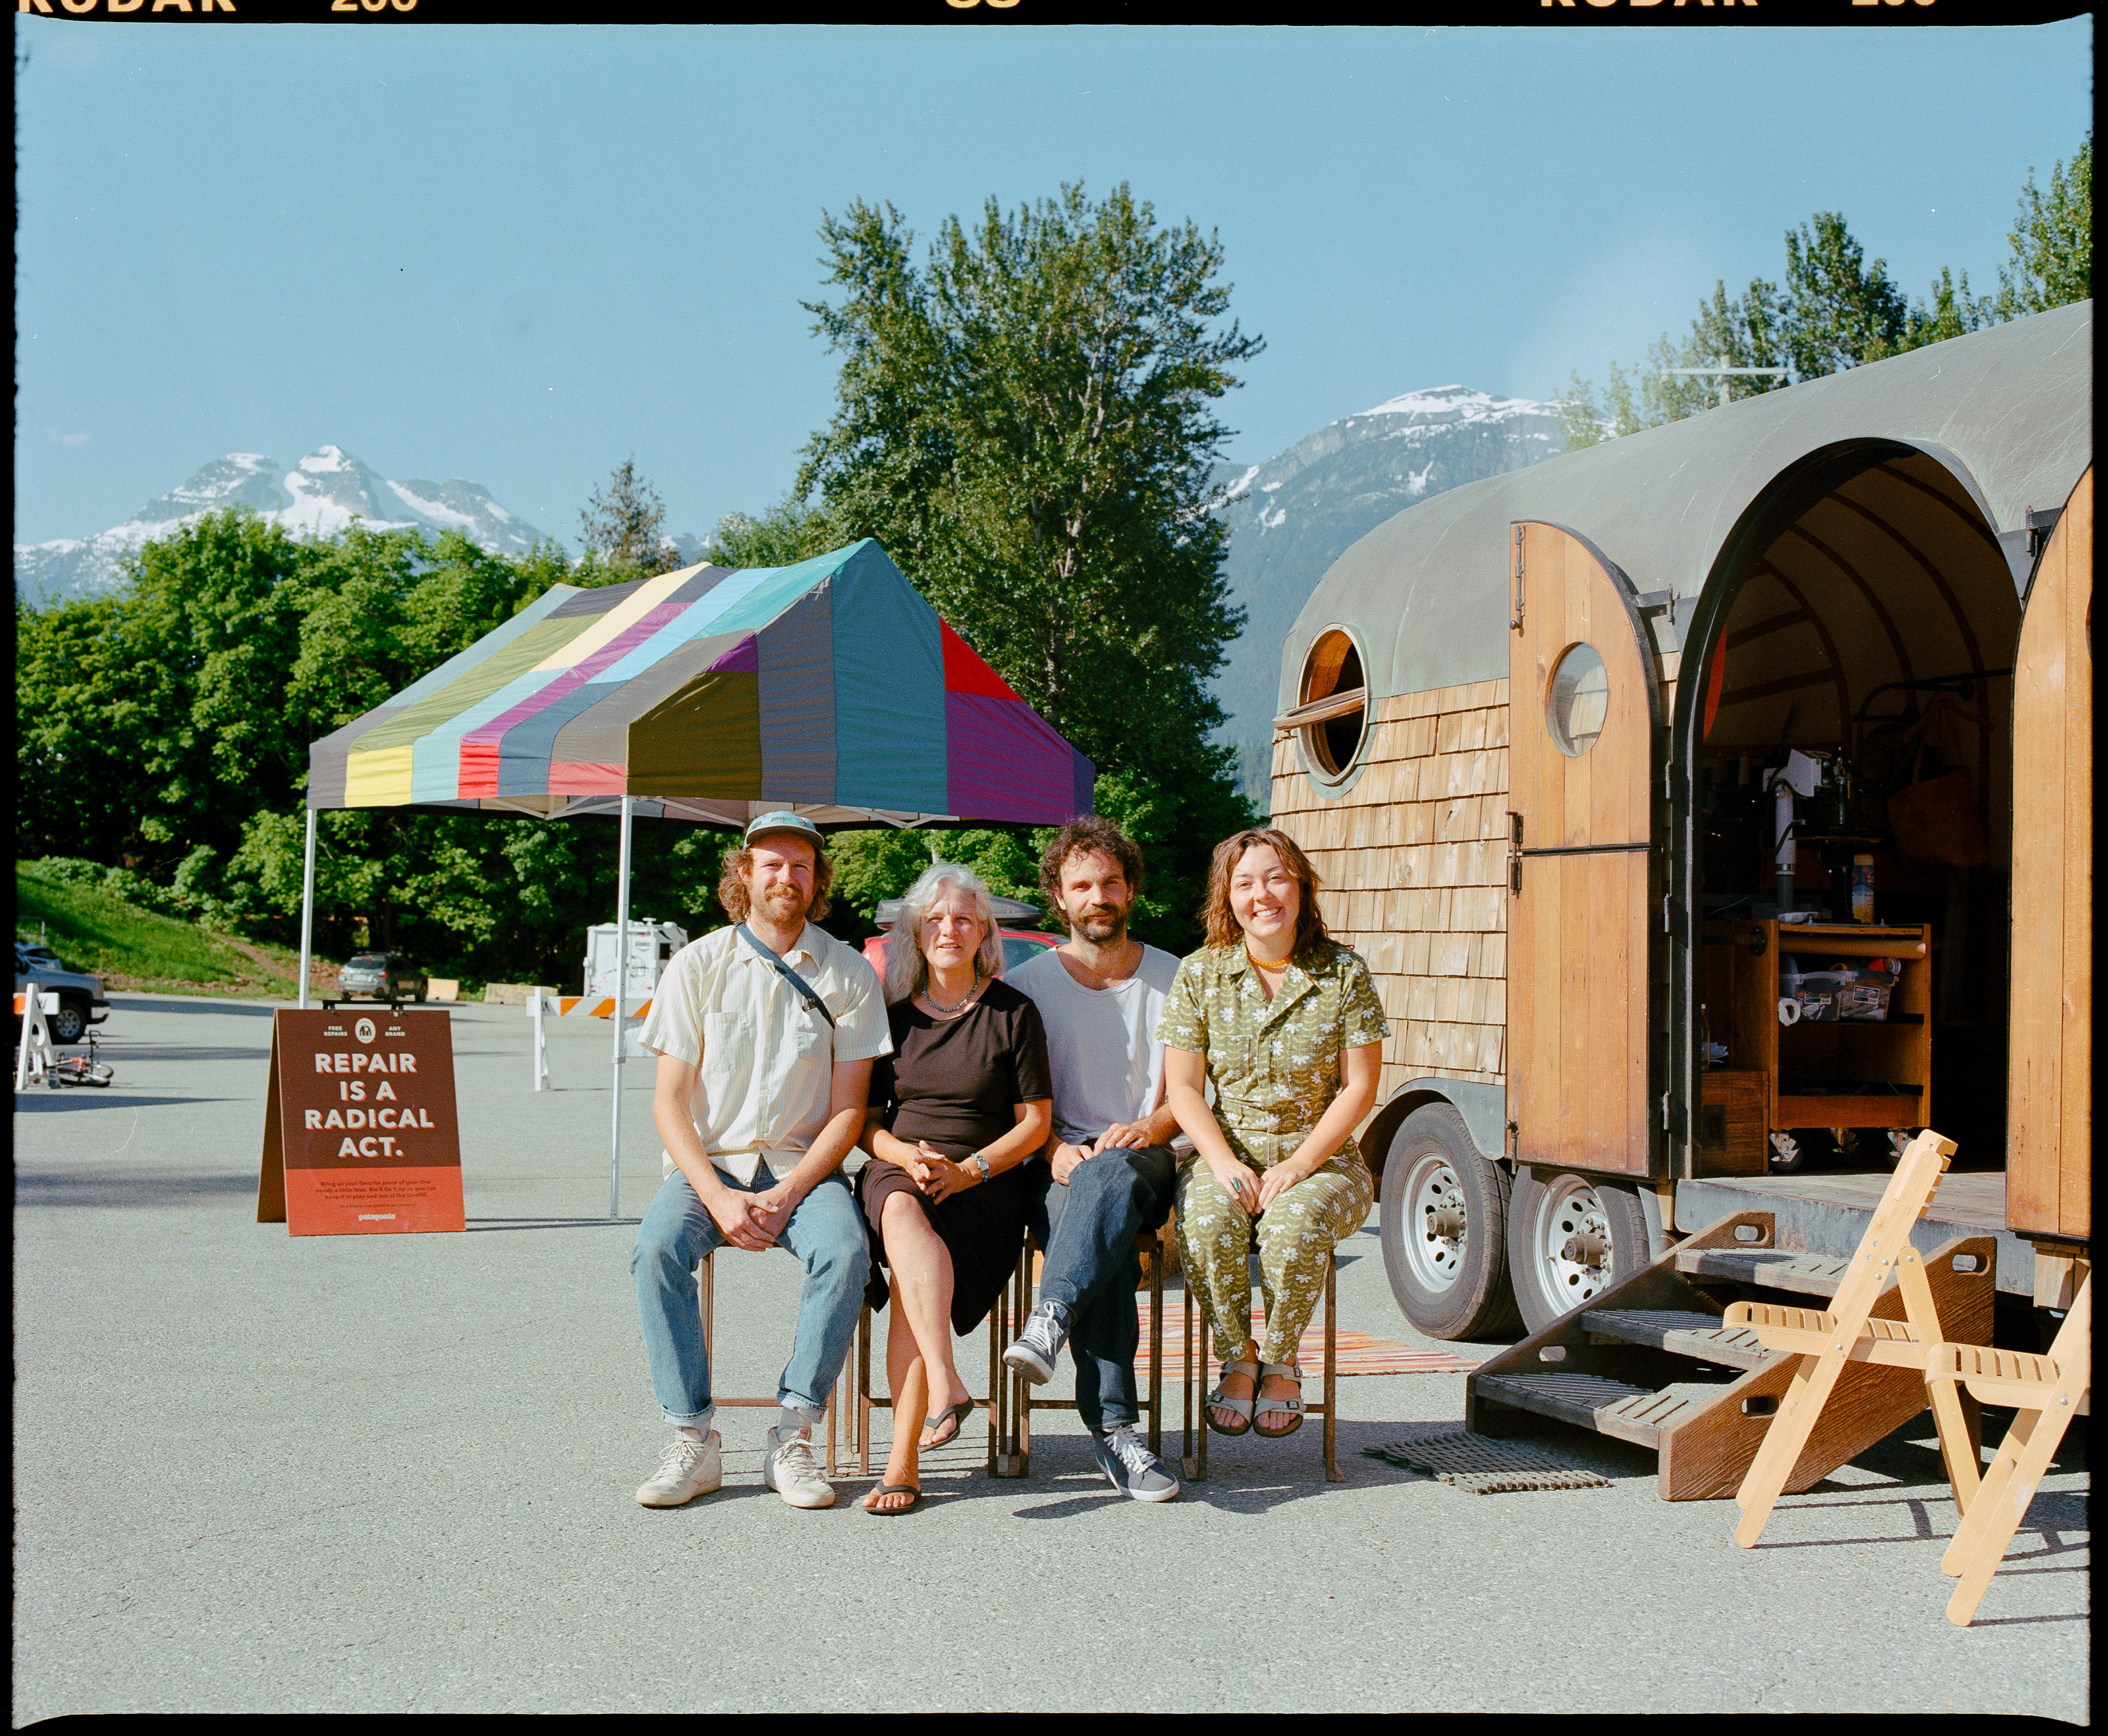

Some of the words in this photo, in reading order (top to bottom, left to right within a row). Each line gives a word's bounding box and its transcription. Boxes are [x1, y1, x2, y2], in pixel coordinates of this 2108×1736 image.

[315, 1053, 418, 1073] REPAIR
[340, 1081, 366, 1101] IS
[375, 1081, 397, 1101] A
[305, 1108, 435, 1130] RADICAL
[338, 1137, 404, 1158] ACT.
[358, 1212, 396, 1221] patagonia
